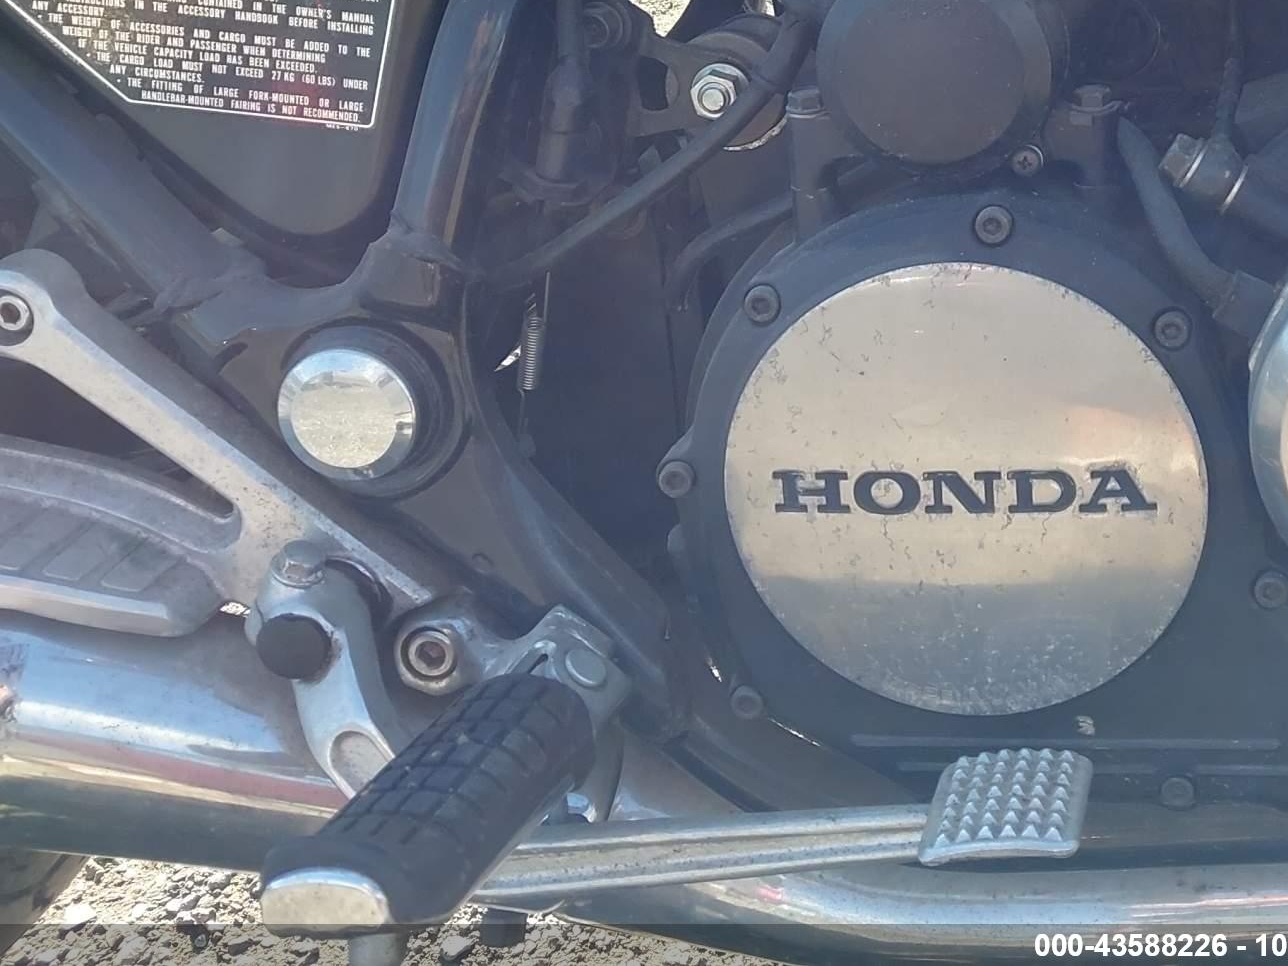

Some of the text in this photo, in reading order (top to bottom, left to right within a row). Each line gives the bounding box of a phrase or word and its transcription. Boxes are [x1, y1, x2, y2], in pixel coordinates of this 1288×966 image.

[31, 0, 49, 11] ANY
[134, 0, 144, 10] IN
[152, 1, 167, 12] THE
[177, 4, 225, 18] ACCESSORY
[235, 10, 278, 24] HANDBOOK
[288, 16, 318, 29] BEFORE
[327, 20, 373, 35] INSTALLING
[252, 1, 262, 11] IN
[272, 3, 286, 15] THE
[295, 5, 332, 19] OWNER'S
[341, 11, 374, 24] MANUAL
[48, 12, 370, 58] THE WEIGHT OF ACCESSORIES AND CARGO MUST BE ADDED TO THE
[62, 25, 325, 63] WEIGHT OF THE RIDER AND PASSENGER WHEN DETERMINING
[78, 37, 87, 48] IF
[93, 39, 110, 51] THE
[114, 41, 147, 55] VEHICLE
[153, 46, 193, 59] CAPACITY
[199, 51, 220, 63] LOAD
[226, 54, 242, 65] HAS
[249, 56, 269, 68] BEEN
[96, 51, 110, 62] THE
[119, 53, 144, 66] CARGO
[153, 57, 173, 69] LOAD
[181, 60, 203, 71] MUST
[211, 64, 227, 74] NOT
[235, 66, 264, 78] EXCEED
[343, 78, 368, 90] UNDER
[109, 63, 126, 75] ANY
[127, 76, 363, 112] THE FITTING OF LARGE FORK-MOUNTED OR LARGE
[141, 90, 224, 107] HANDLEBAR-MOUNTED
[230, 99, 261, 112] FAIRING
[267, 103, 276, 113] IS
[281, 104, 297, 115] NOT
[772, 468, 1158, 514] HONDA
